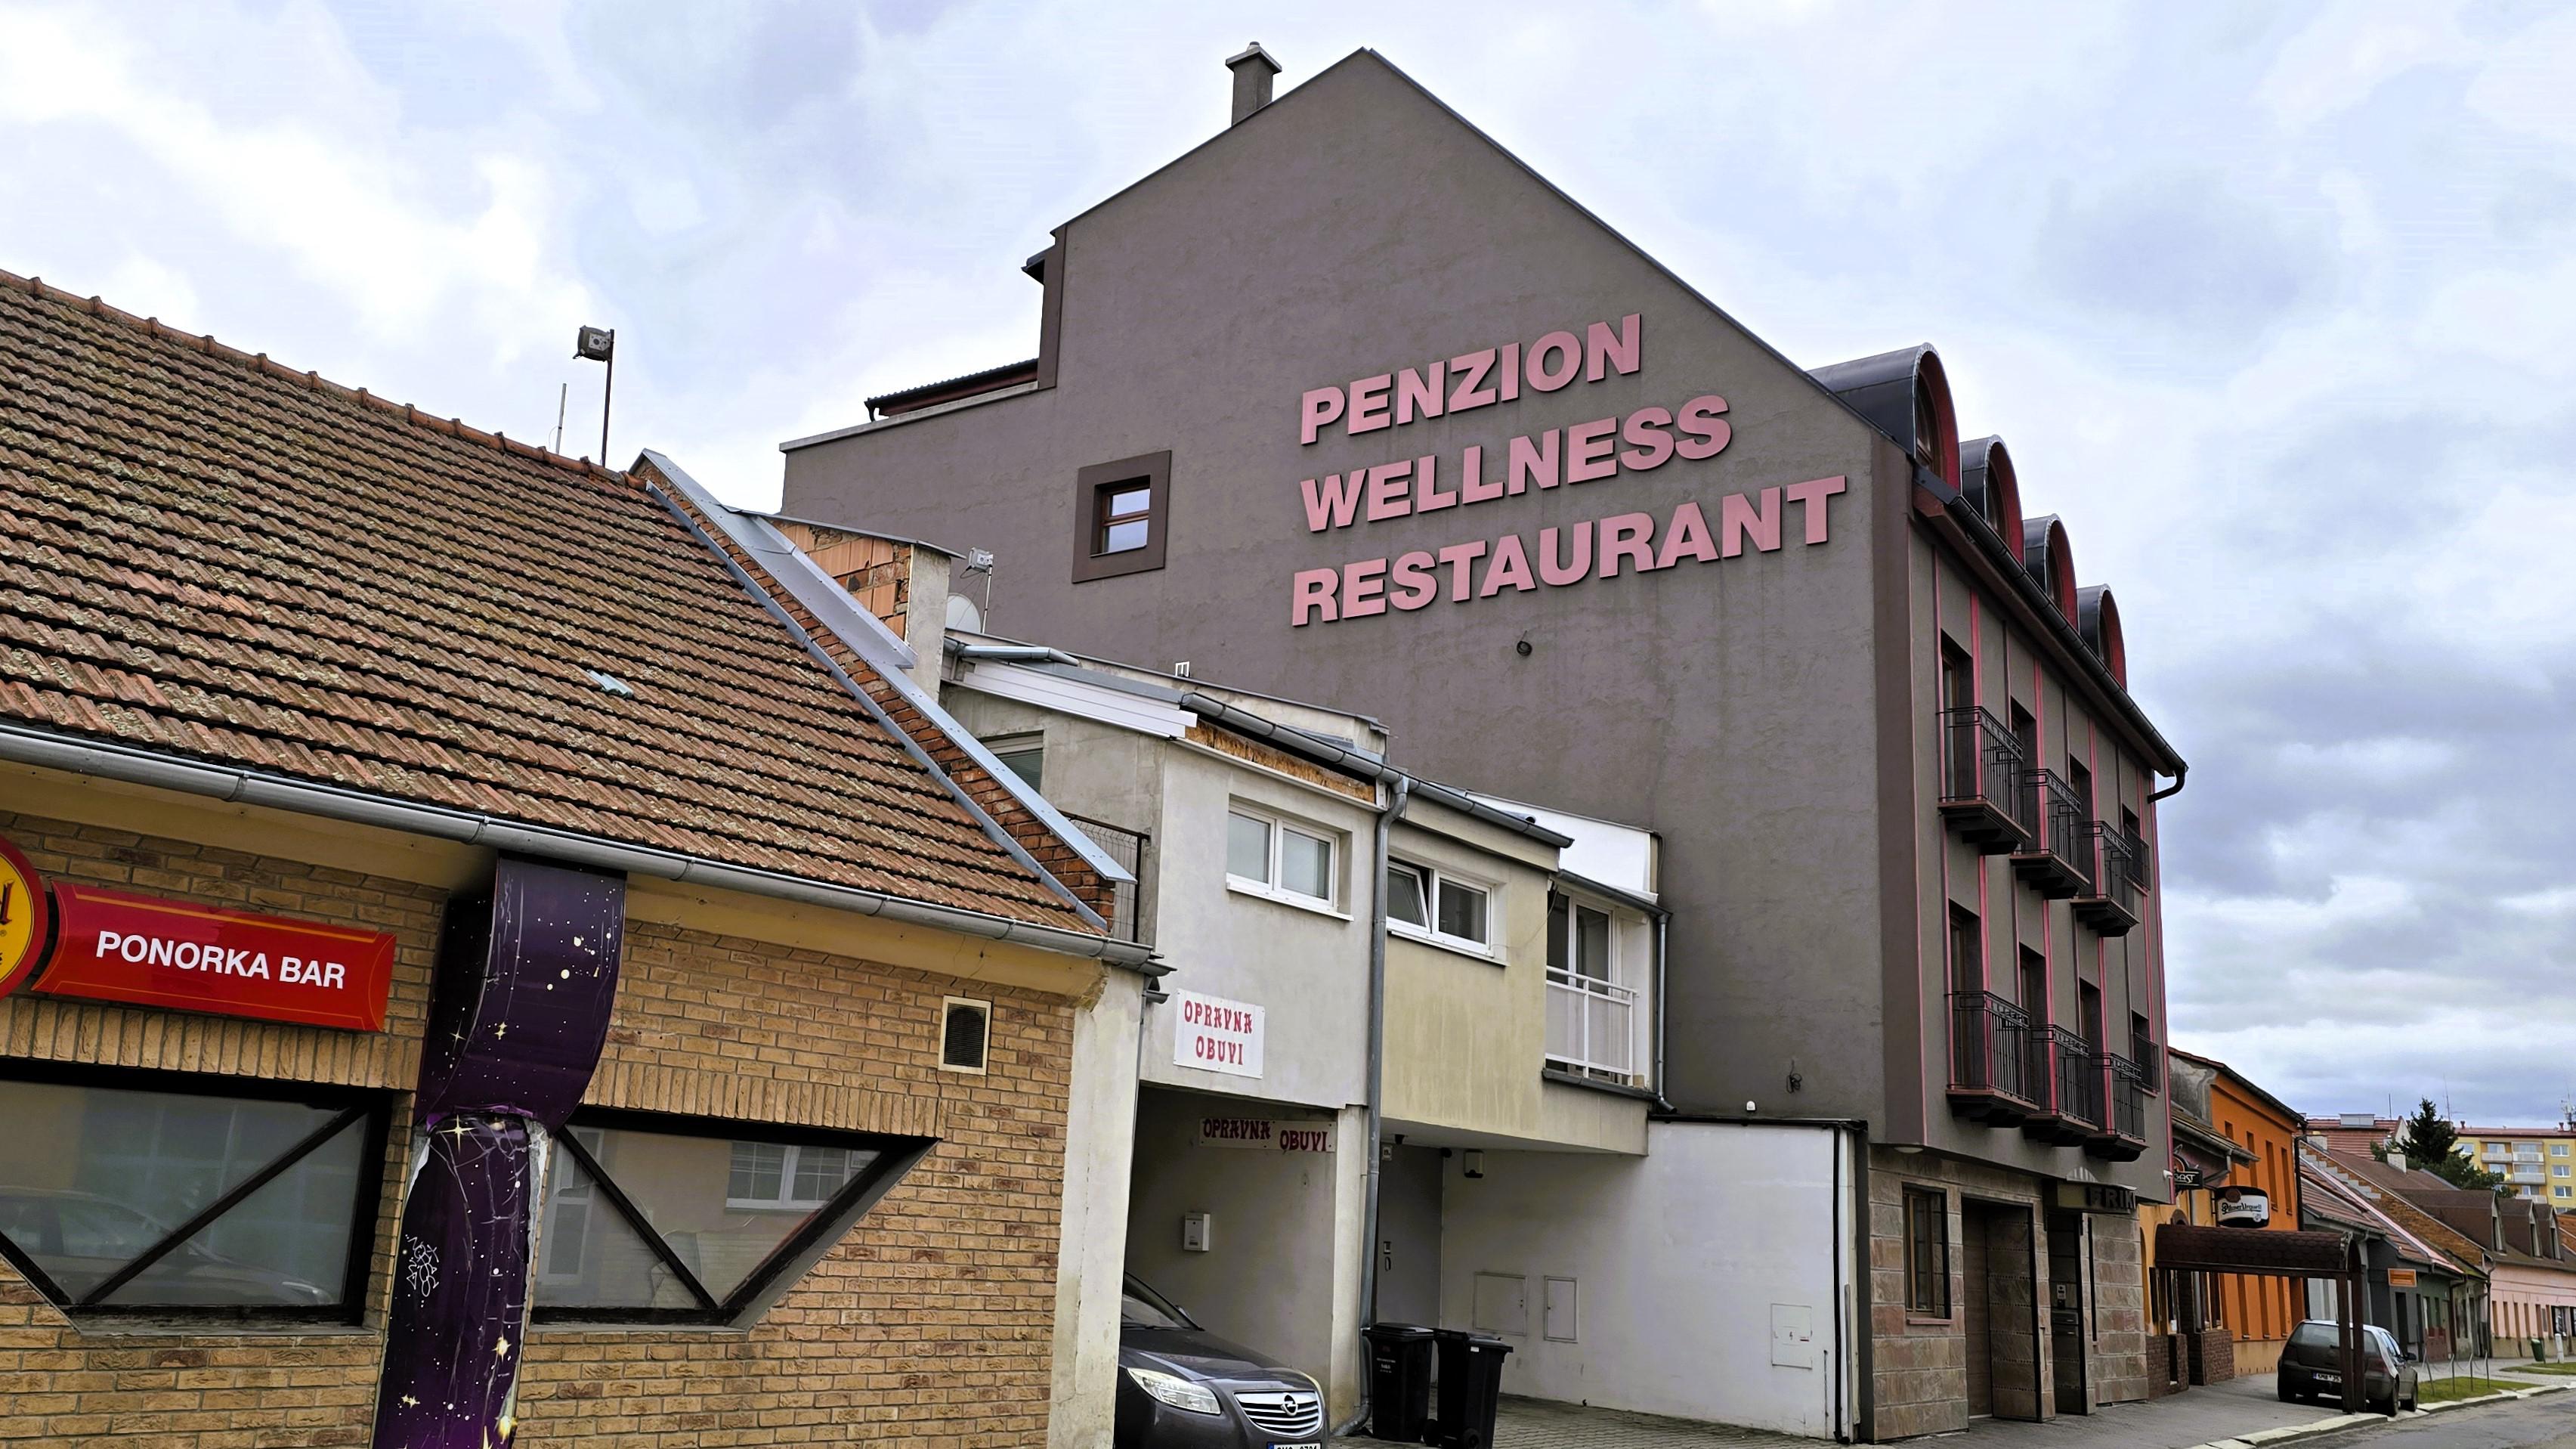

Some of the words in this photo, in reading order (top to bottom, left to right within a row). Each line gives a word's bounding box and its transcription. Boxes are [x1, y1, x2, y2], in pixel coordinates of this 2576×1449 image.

[1301, 314, 1641, 444] PENZION
[1301, 395, 1732, 532] WELLNESS
[1292, 475, 1846, 627] RESTAURANT
[96, 930, 270, 980] PONORKA
[279, 956, 346, 990] BAR
[1184, 1000, 1253, 1034] OPRAVNA
[1195, 1036, 1244, 1065] OBUVI
[1203, 1118, 1271, 1140] OPRAVNA
[1279, 1130, 1328, 1152] OBUVI
